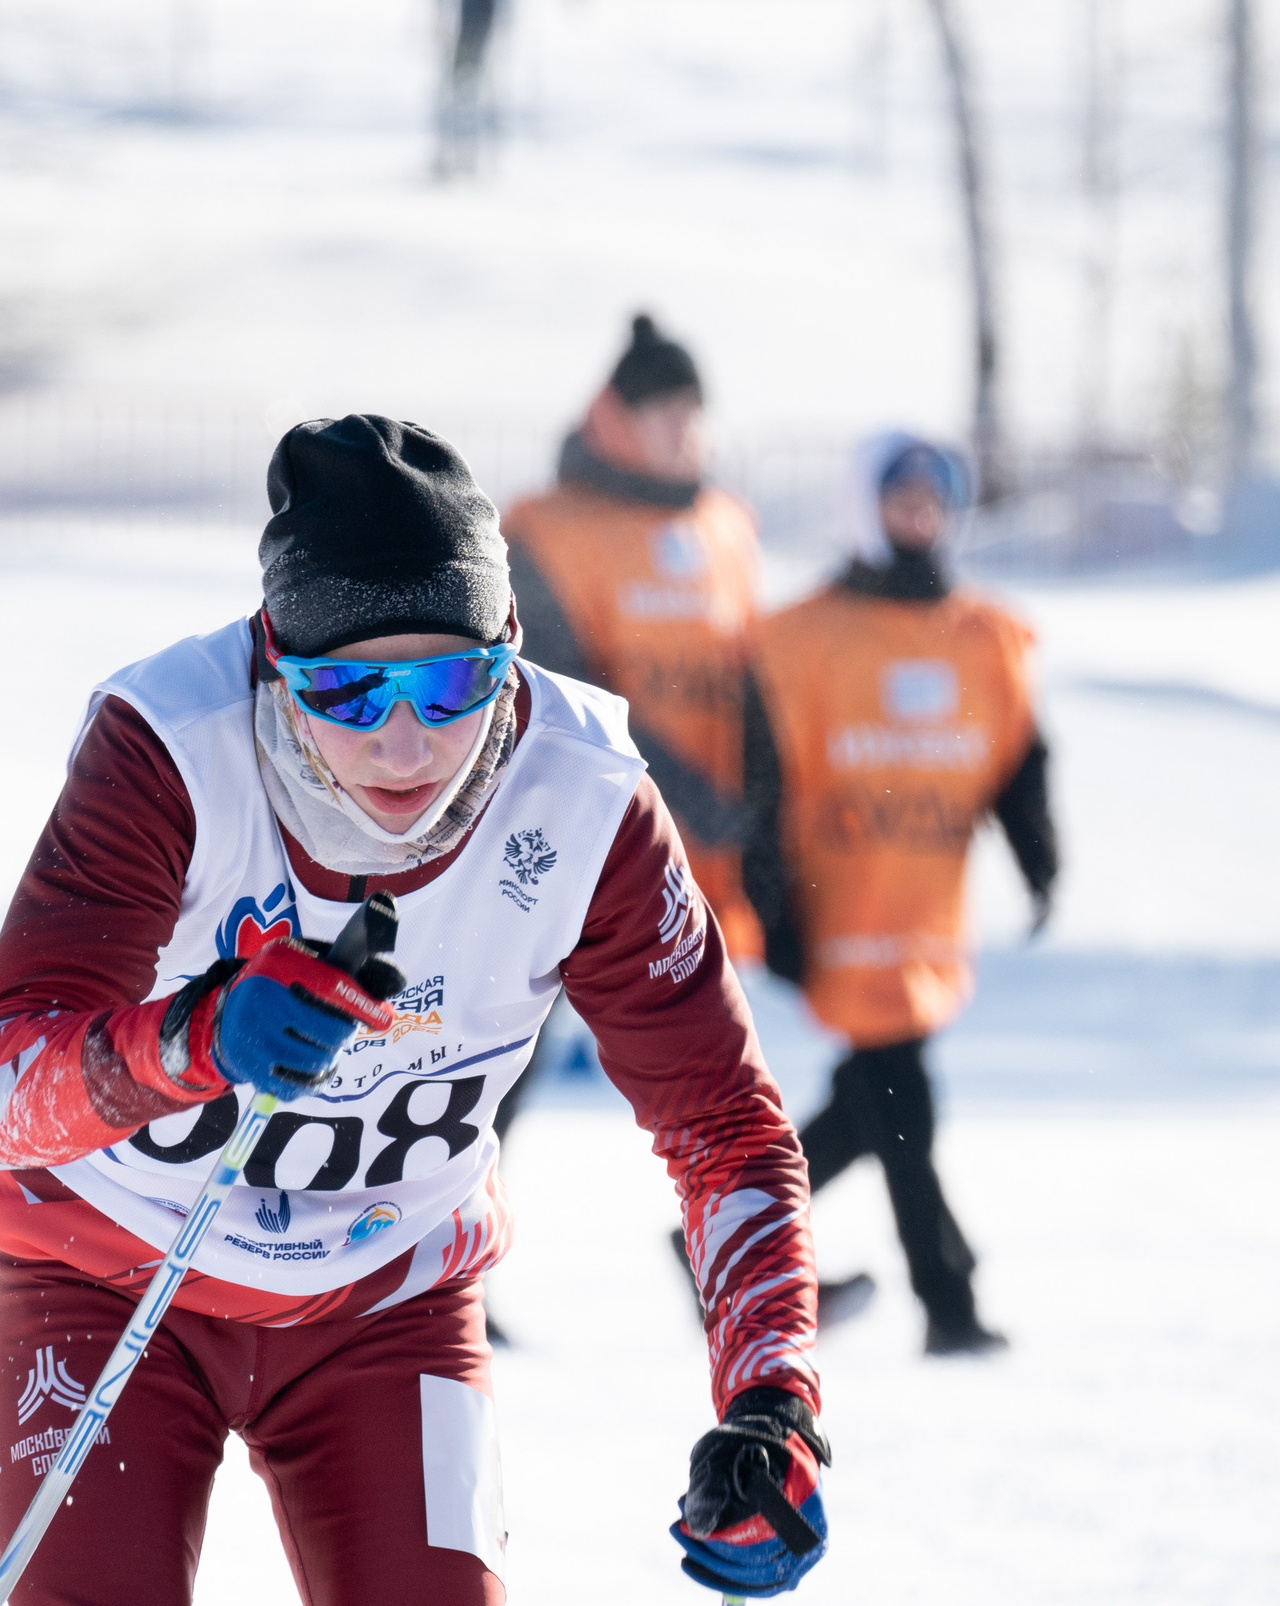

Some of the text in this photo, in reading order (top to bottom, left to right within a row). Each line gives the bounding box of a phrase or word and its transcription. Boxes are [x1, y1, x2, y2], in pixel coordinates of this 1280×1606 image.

[498, 879, 539, 906] МИНСПОРТ
[501, 889, 531, 914] РОССИИ
[223, 1234, 331, 1261] РЕЗЕРВ РОССИИ
